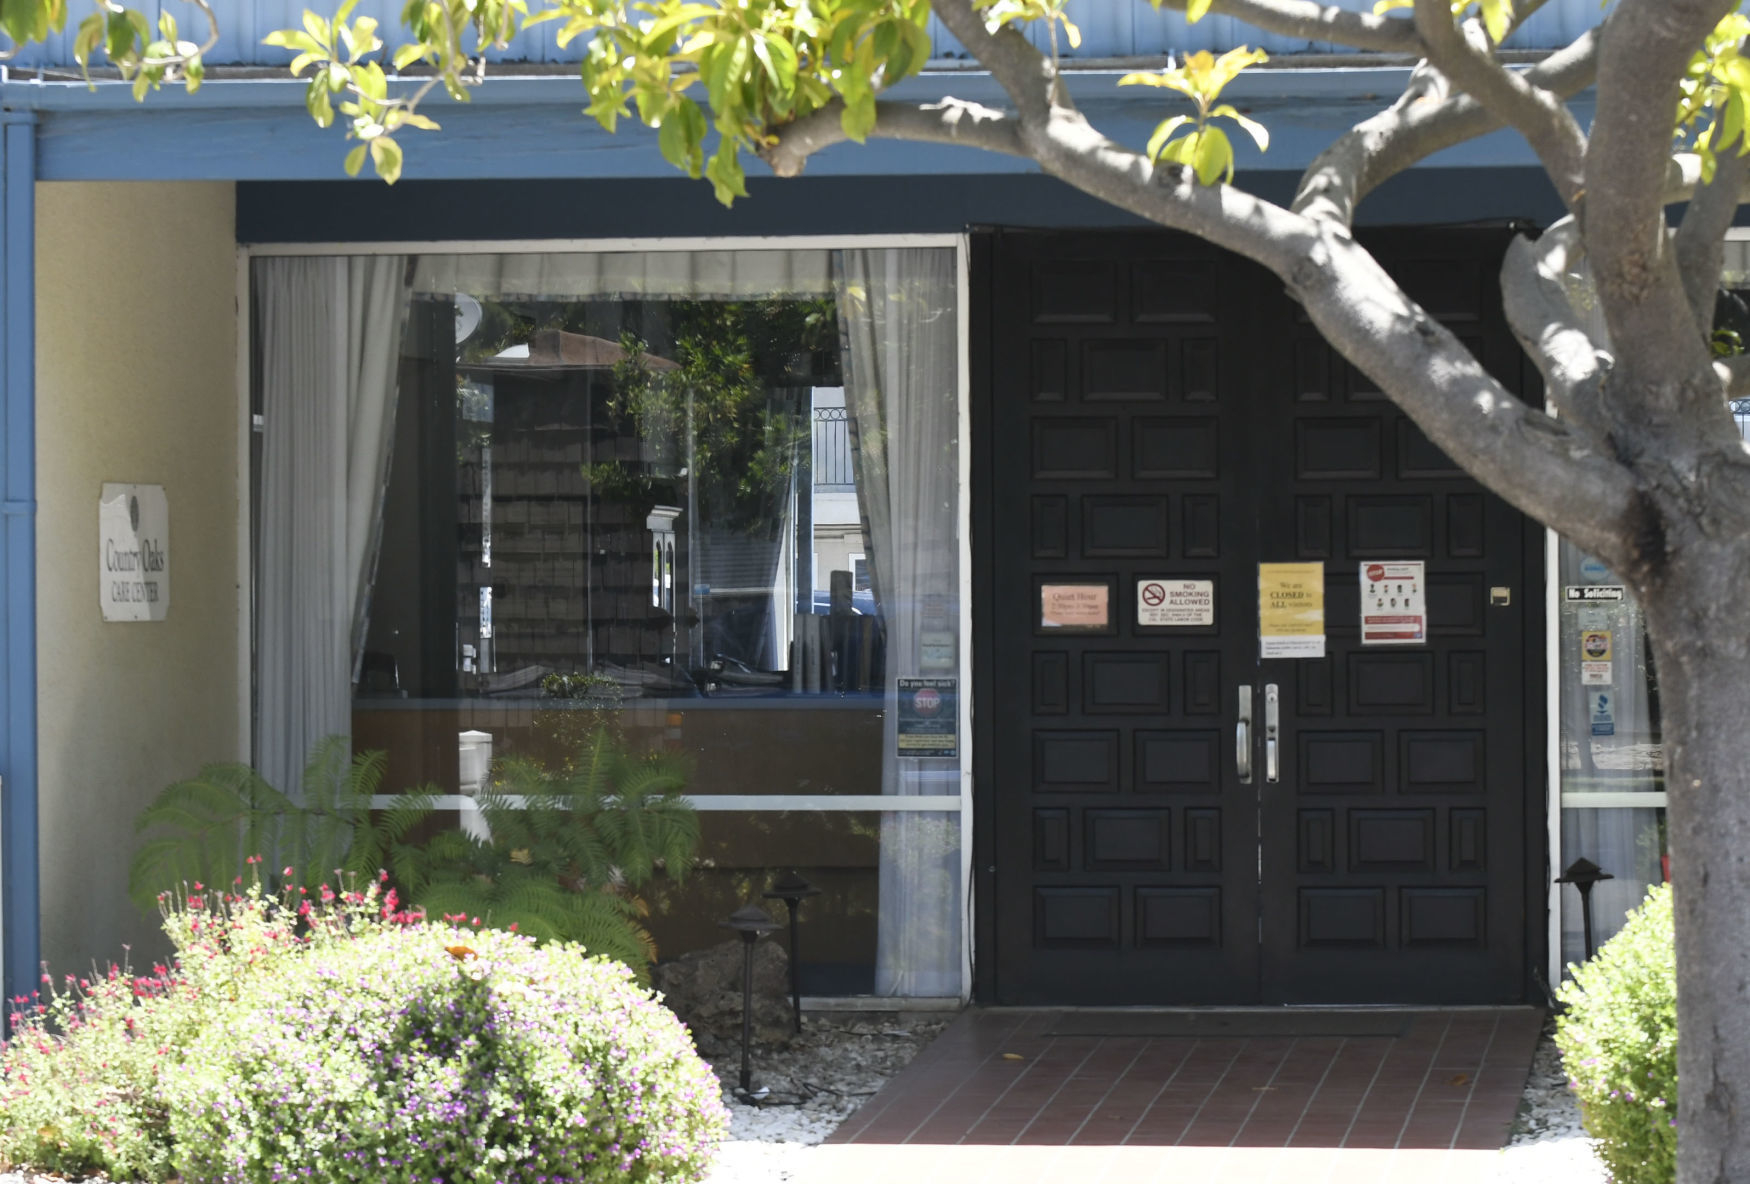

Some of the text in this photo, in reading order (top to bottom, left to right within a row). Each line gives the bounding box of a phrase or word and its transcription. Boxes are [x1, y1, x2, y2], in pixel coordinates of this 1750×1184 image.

[106, 538, 164, 572] Country Oaks
[112, 580, 159, 602] CARE CENTER
[1076, 591, 1097, 601] Hour
[1270, 592, 1304, 600] CLOSED
[1568, 588, 1623, 600] No Soliciting
[1271, 601, 1287, 609] ALL
[914, 697, 941, 708] STOP
